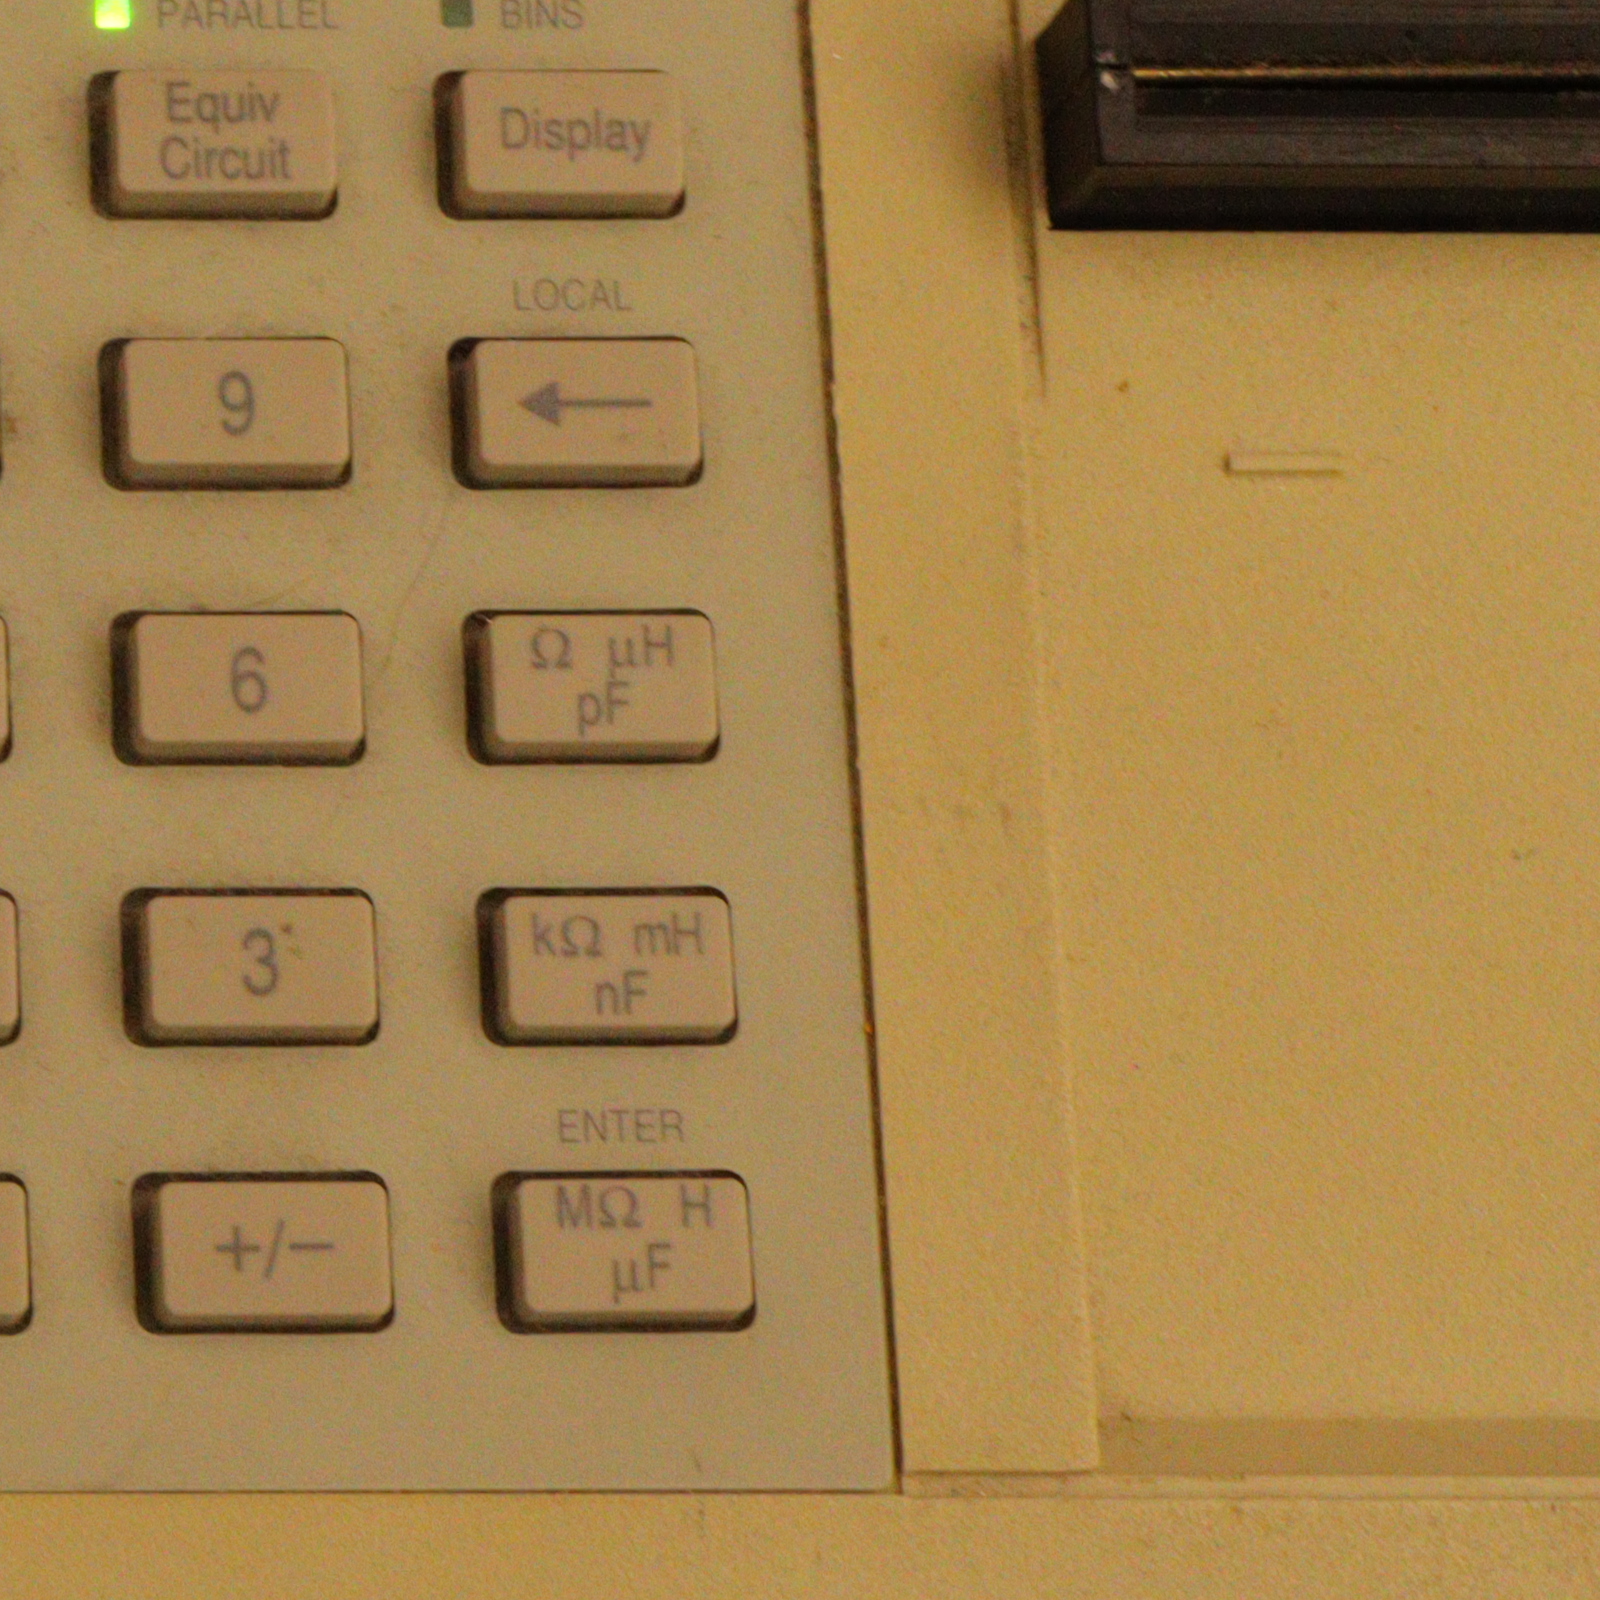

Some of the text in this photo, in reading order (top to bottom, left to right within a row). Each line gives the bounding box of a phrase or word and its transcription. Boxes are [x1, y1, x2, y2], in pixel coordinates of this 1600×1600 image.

[163, 79, 281, 130] Equiv
[158, 134, 292, 179] Circuit
[499, 105, 652, 164] Display
[511, 276, 633, 313] LOCAL
[216, 369, 256, 438] 9
[229, 645, 270, 716] 6
[575, 680, 632, 737] pF
[532, 914, 705, 960] kΩ mH
[240, 926, 281, 998] 3
[593, 968, 649, 1012] nF
[556, 1107, 685, 1145] ENTER
[680, 1184, 712, 1227] H
